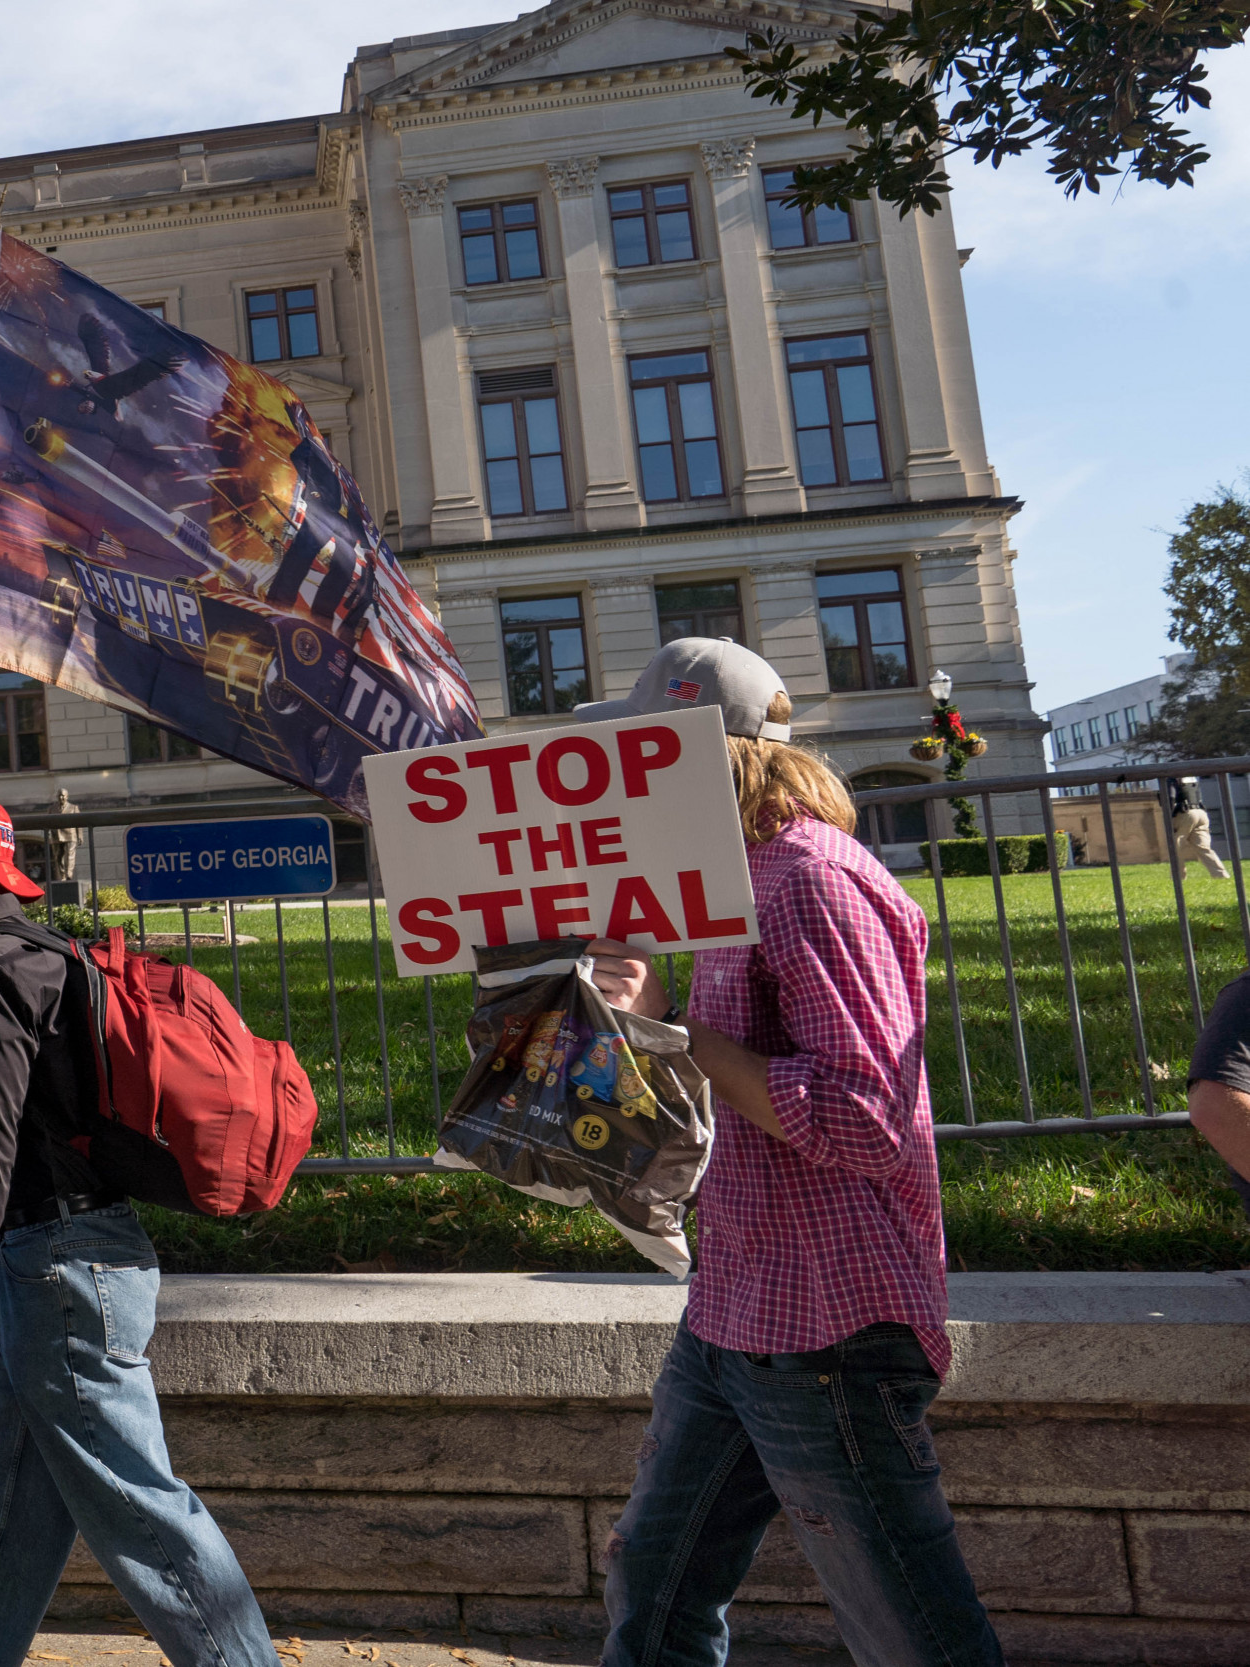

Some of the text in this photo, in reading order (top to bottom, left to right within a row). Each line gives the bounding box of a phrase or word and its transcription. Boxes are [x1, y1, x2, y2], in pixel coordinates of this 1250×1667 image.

[75, 560, 198, 623] TRUMP
[345, 664, 438, 751] TRU
[405, 725, 682, 824] STOP
[131, 845, 329, 874] STATE OF GEORGIA
[478, 816, 628, 876] THE
[398, 869, 748, 965] STEAL
[542, 1109, 563, 1126] MIX
[582, 1121, 603, 1141] 18
